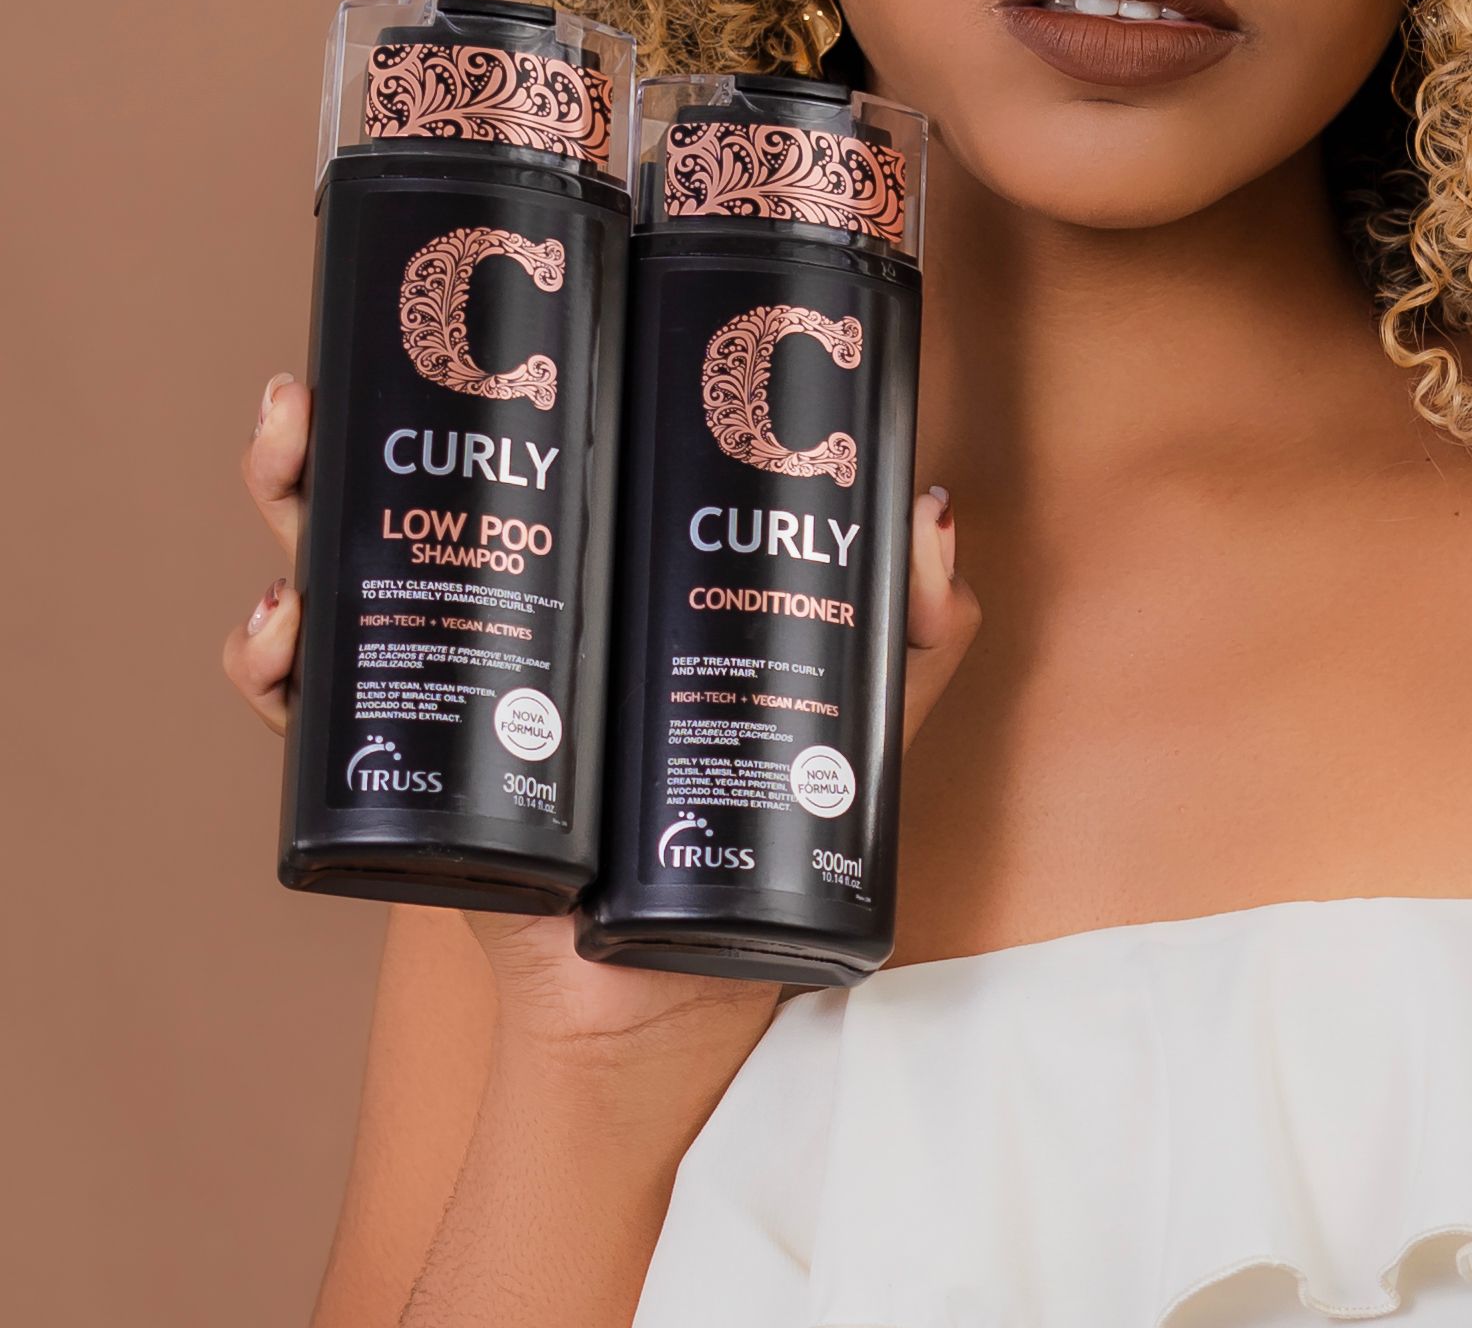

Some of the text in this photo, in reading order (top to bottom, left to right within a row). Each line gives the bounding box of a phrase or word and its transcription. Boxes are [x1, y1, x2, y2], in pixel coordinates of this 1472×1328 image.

[384, 429, 559, 490] CURLY
[383, 509, 552, 555] LOW POO
[689, 506, 860, 567] CURLY
[412, 543, 524, 574] SHAMPOO
[362, 580, 565, 611] GENTLY CLEANSES PROVIDING VITALITY
[362, 590, 535, 614] TO EXTREMELY DAMAGED CURLS.
[689, 587, 855, 627] CONDITIONER
[360, 615, 425, 627] HIGH-TECH
[442, 617, 483, 632] VEGAN
[486, 624, 533, 641] ACTIVES
[358, 644, 385, 652] LIMPA
[387, 644, 448, 653] SUAVEMENTE
[458, 647, 501, 661] PROMOVE
[503, 653, 551, 670] VITALIDADE
[358, 660, 424, 669] FRAGILIZADOS.
[379, 652, 417, 660] CACHOS
[427, 653, 446, 662] AOS
[447, 654, 469, 664] FIOS
[470, 657, 522, 672] ALTAMENTE
[672, 656, 825, 677] DEEP TREATMENT FOR CURLY
[672, 667, 758, 679] AND WAVY HAIR.
[357, 681, 386, 689] CURLY
[424, 683, 455, 692] VEGAN
[356, 691, 385, 699] BLEND
[388, 691, 400, 699] OF
[402, 692, 442, 701] MIRACLE
[355, 701, 438, 711] AVOCADO OIL AND
[671, 692, 736, 704] HIGH-TECH
[752, 694, 793, 709] VEGAN
[794, 700, 839, 717] ACTIVES
[355, 710, 417, 720] AMARANTHUS
[512, 709, 545, 725] NOVA
[501, 718, 554, 741] FÓRMULA
[670, 720, 777, 732] TRATAMENTO INTENSIVO
[668, 736, 740, 746] OU ONDULADOS.
[669, 728, 794, 743] PARA CABELOS CACHEADOS
[667, 758, 697, 766] CURLY
[358, 769, 443, 793] TRUSS
[715, 778, 746, 787] VEGAN
[806, 770, 839, 781] NOVA
[503, 773, 557, 802] 300ml
[666, 787, 711, 795] AVOCADO
[731, 789, 766, 798] CEREAL
[799, 779, 850, 795] FÓRMULA
[513, 794, 536, 810] 10.14
[666, 797, 685, 805] AND
[687, 797, 748, 808] AMARANTHUS
[669, 845, 755, 870] TRUSS
[812, 849, 862, 878] 300ml
[821, 871, 844, 885] 10.14
